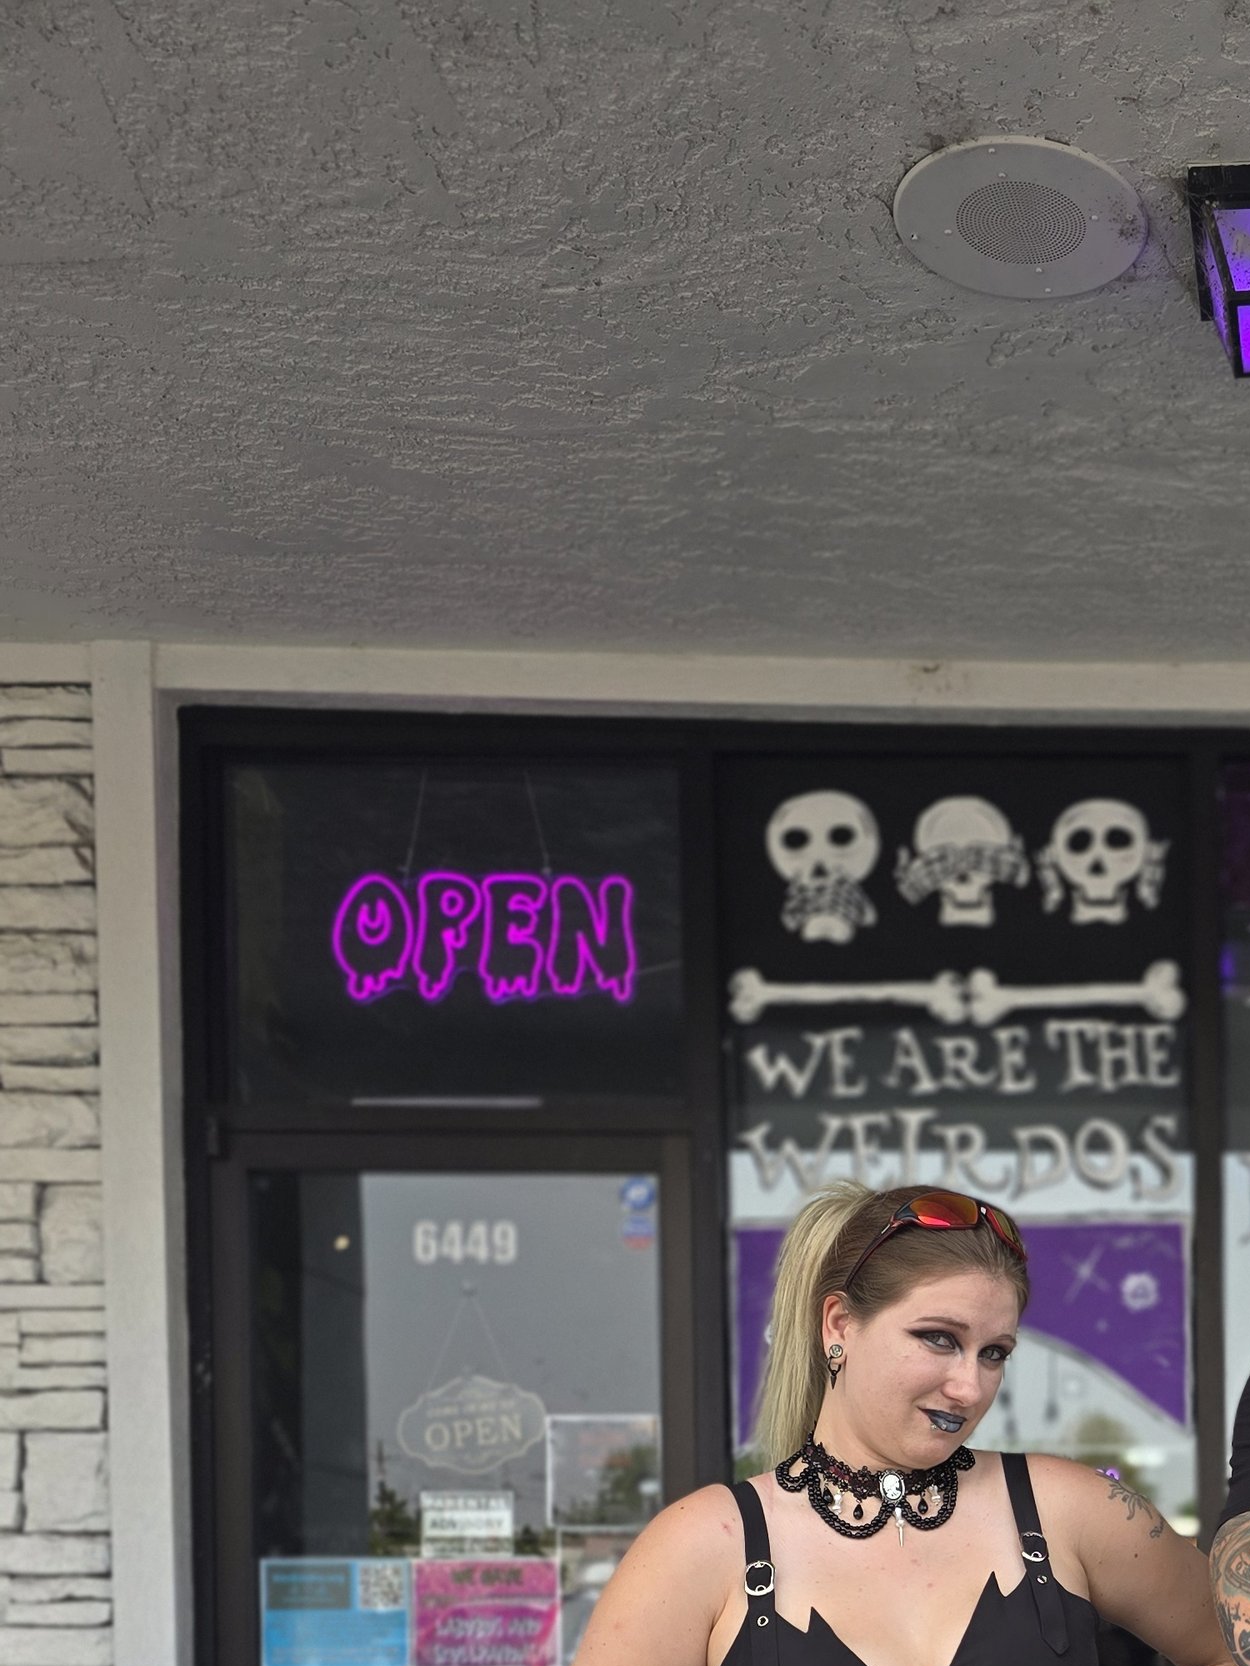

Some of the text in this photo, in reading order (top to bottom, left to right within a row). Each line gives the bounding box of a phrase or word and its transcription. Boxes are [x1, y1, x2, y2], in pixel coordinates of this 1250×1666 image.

[333, 873, 637, 1003] OPEN
[747, 1018, 1182, 1098] WE ARE THE
[738, 1108, 1181, 1202] WEIRDOS
[413, 1220, 519, 1264] 6449
[424, 1413, 523, 1451] OPEN
